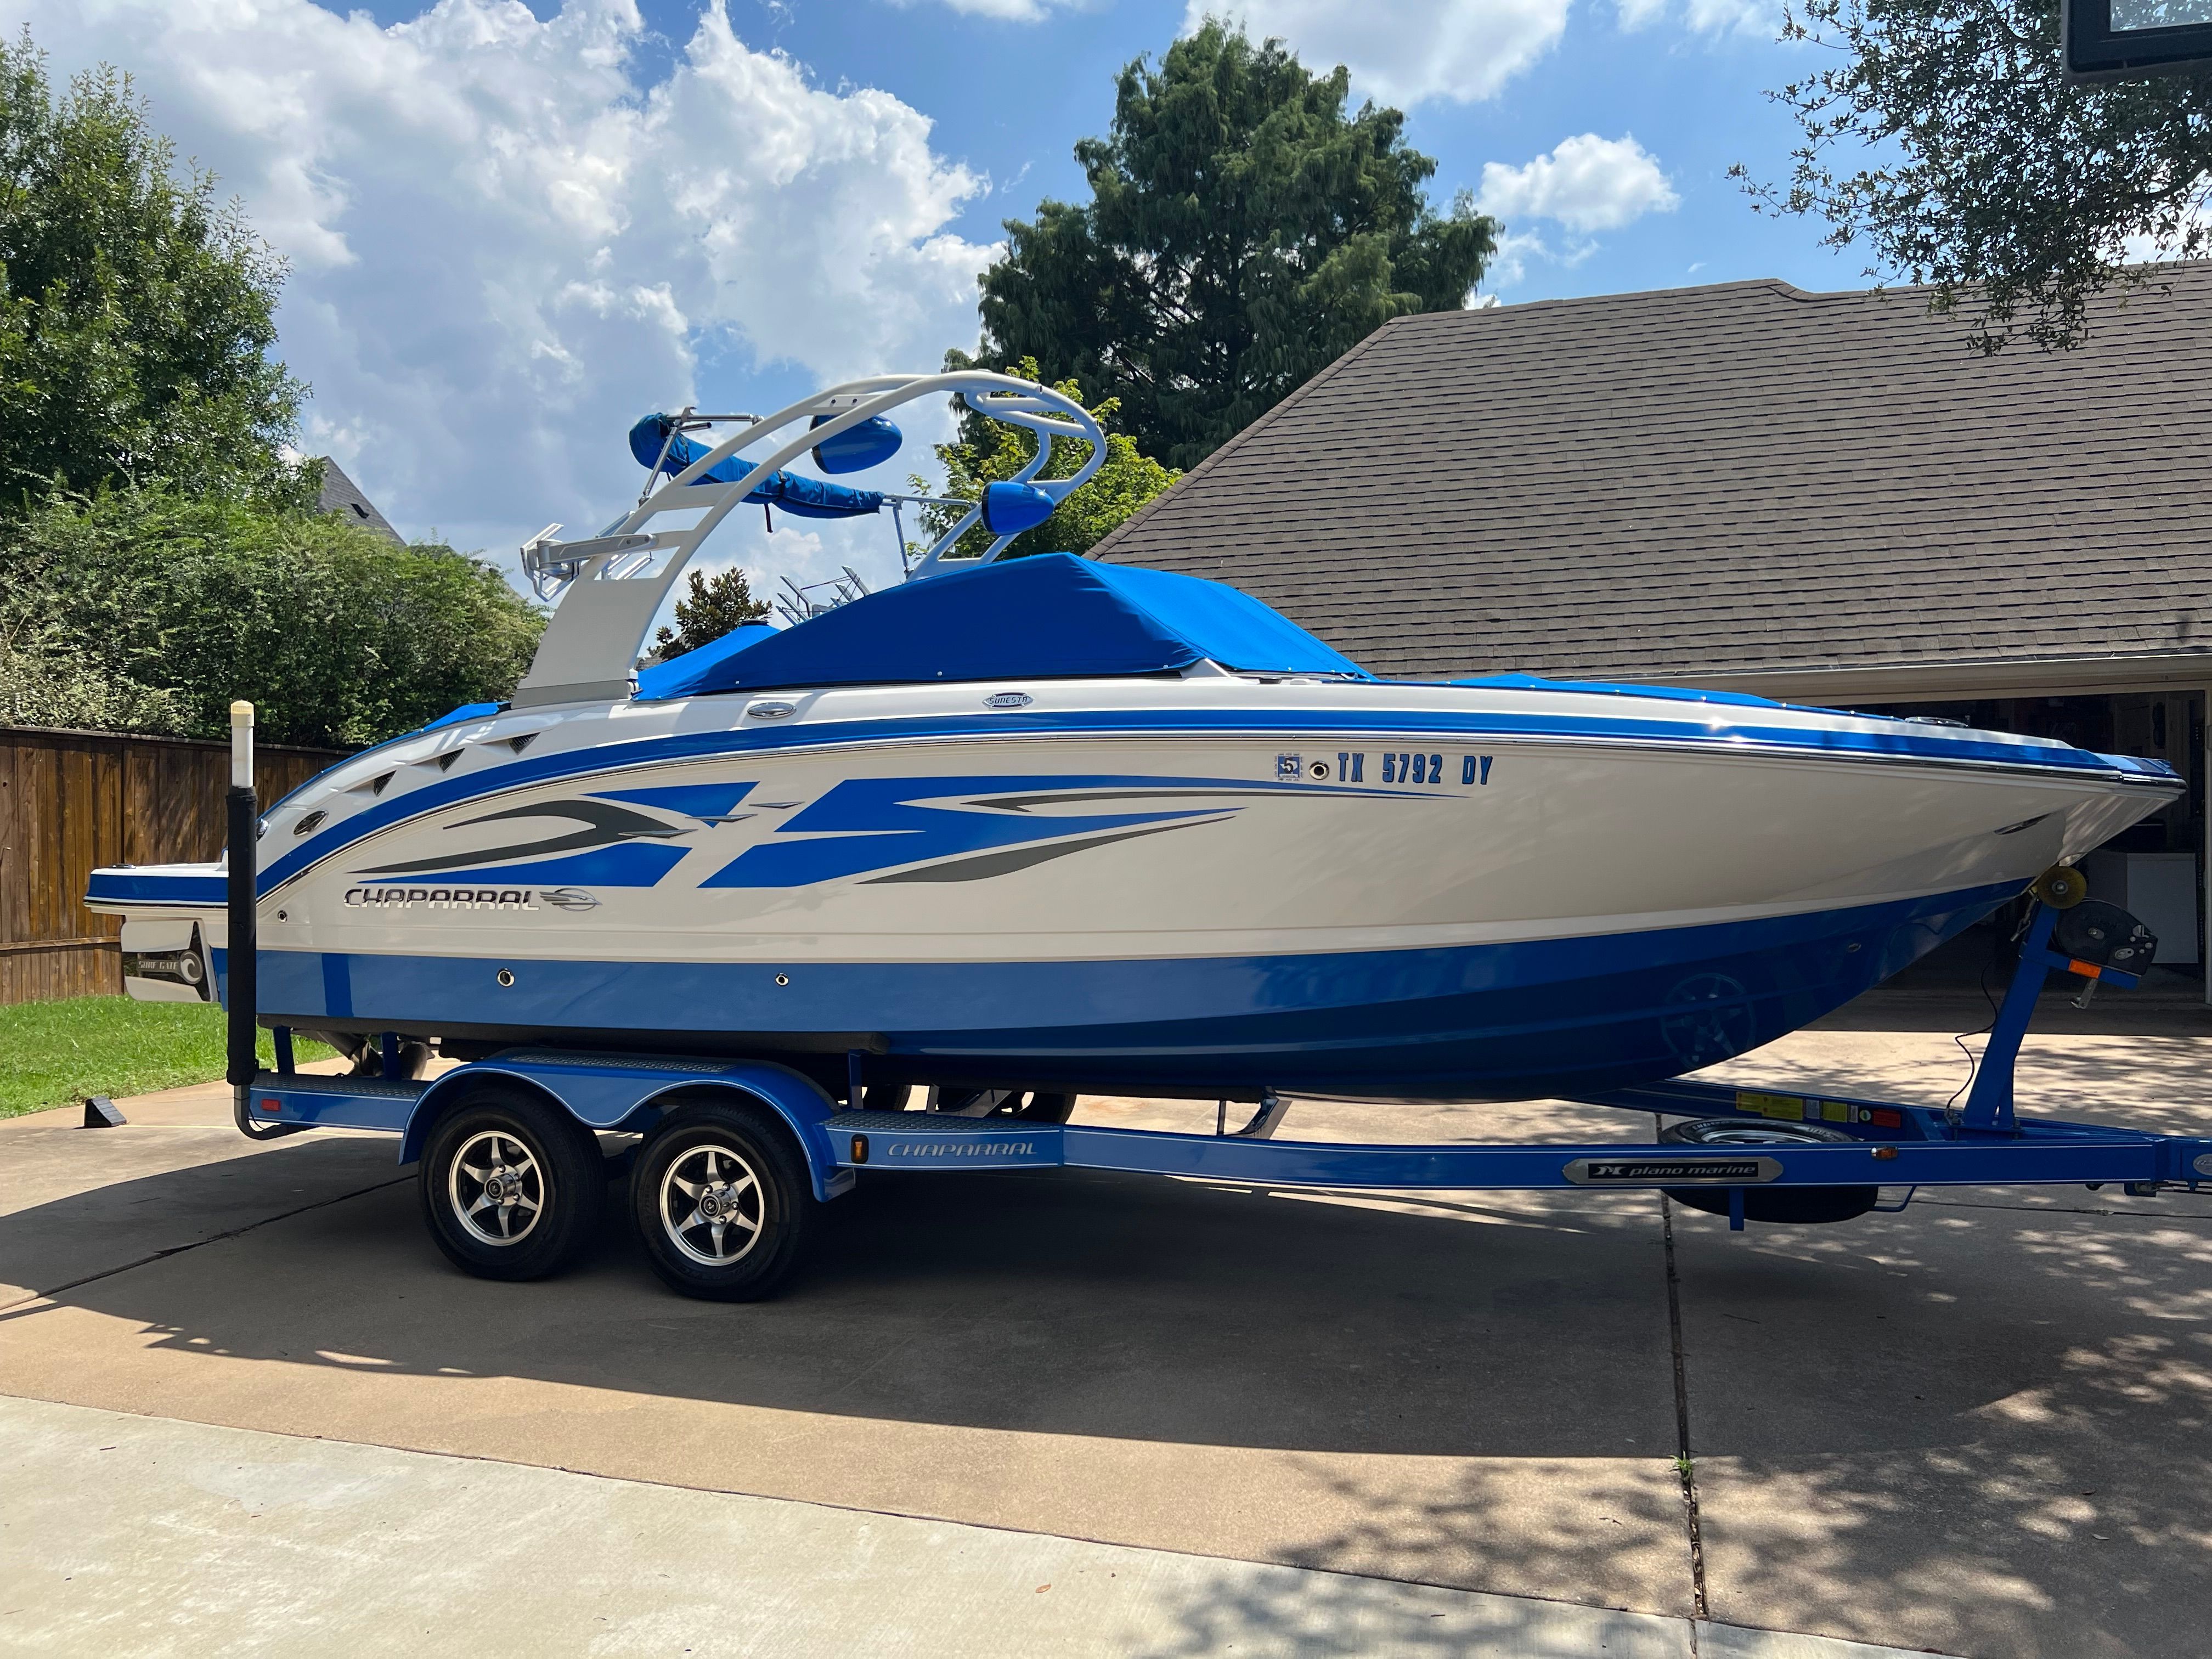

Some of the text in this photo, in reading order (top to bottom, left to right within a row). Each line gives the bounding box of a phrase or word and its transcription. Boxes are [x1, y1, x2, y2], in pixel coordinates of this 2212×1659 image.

[989, 696, 1027, 704] SUNESTA
[1284, 758, 1294, 774] 5
[1338, 752, 1364, 782] TX
[1382, 753, 1443, 784] 5792
[1462, 755, 1493, 785] DY
[343, 888, 540, 911] CHAPARRAL
[138, 961, 178, 970] SURF GATE
[887, 1142, 1038, 1158] CHAPARRAL
[1628, 1165, 1756, 1177] plano marine
